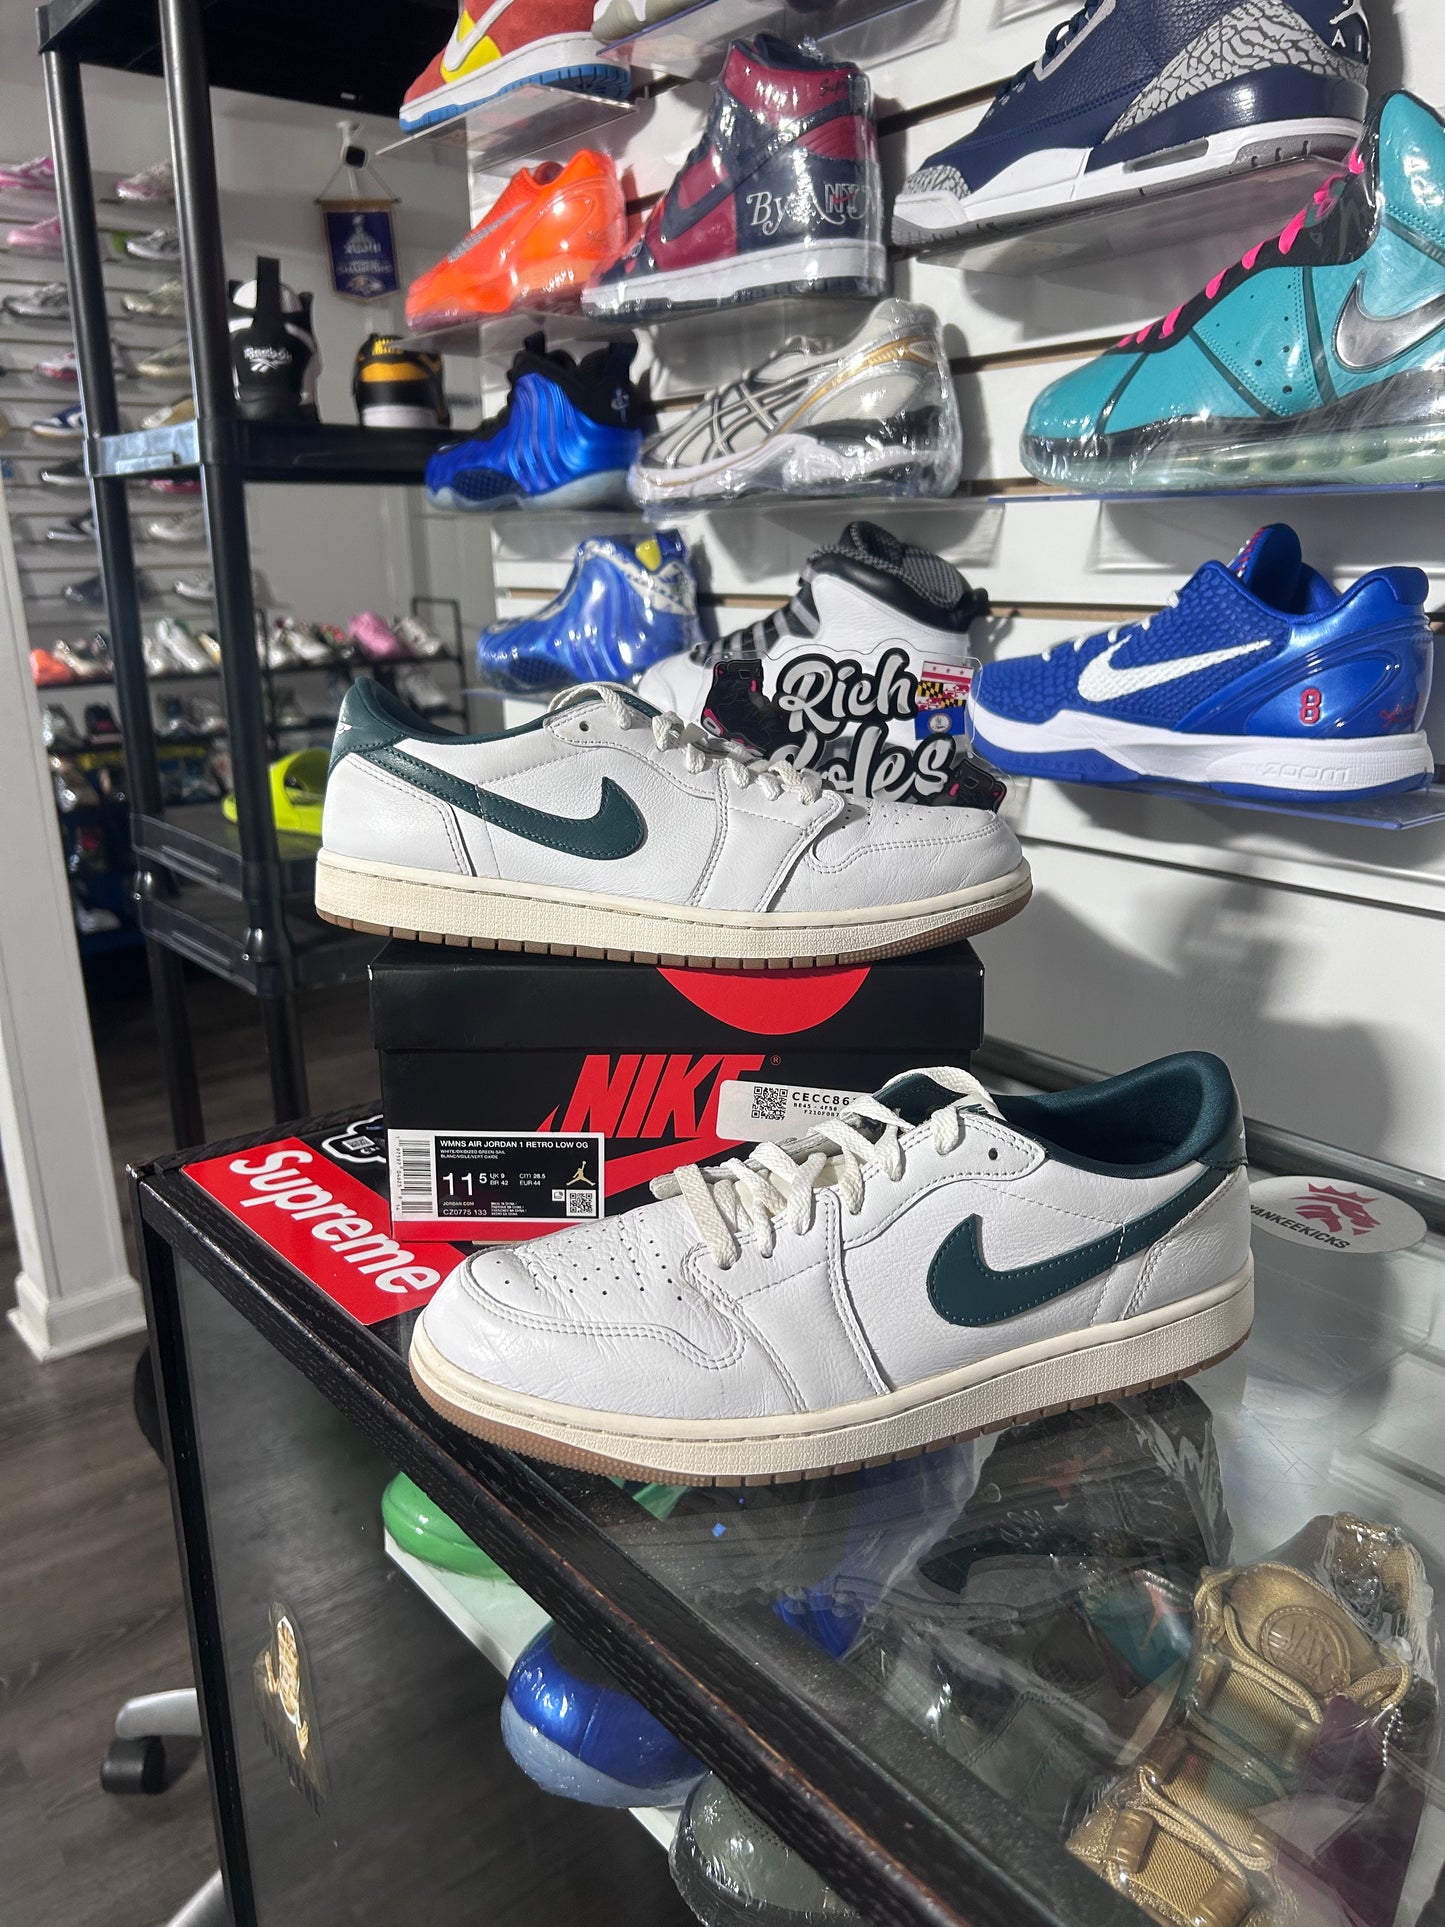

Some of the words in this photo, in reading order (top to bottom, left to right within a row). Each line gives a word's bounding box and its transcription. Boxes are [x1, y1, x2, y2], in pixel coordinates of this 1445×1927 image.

[244, 347, 293, 360] Reebok
[777, 650, 915, 737] Rich
[1299, 687, 1322, 726] 8
[792, 1092, 857, 1106] CECC86
[440, 1140, 467, 1148] WMNS
[468, 1140, 482, 1148] AIR
[526, 1141, 554, 1149] RETRO
[555, 1141, 574, 1149] LOW
[229, 1150, 441, 1293] Supreme
